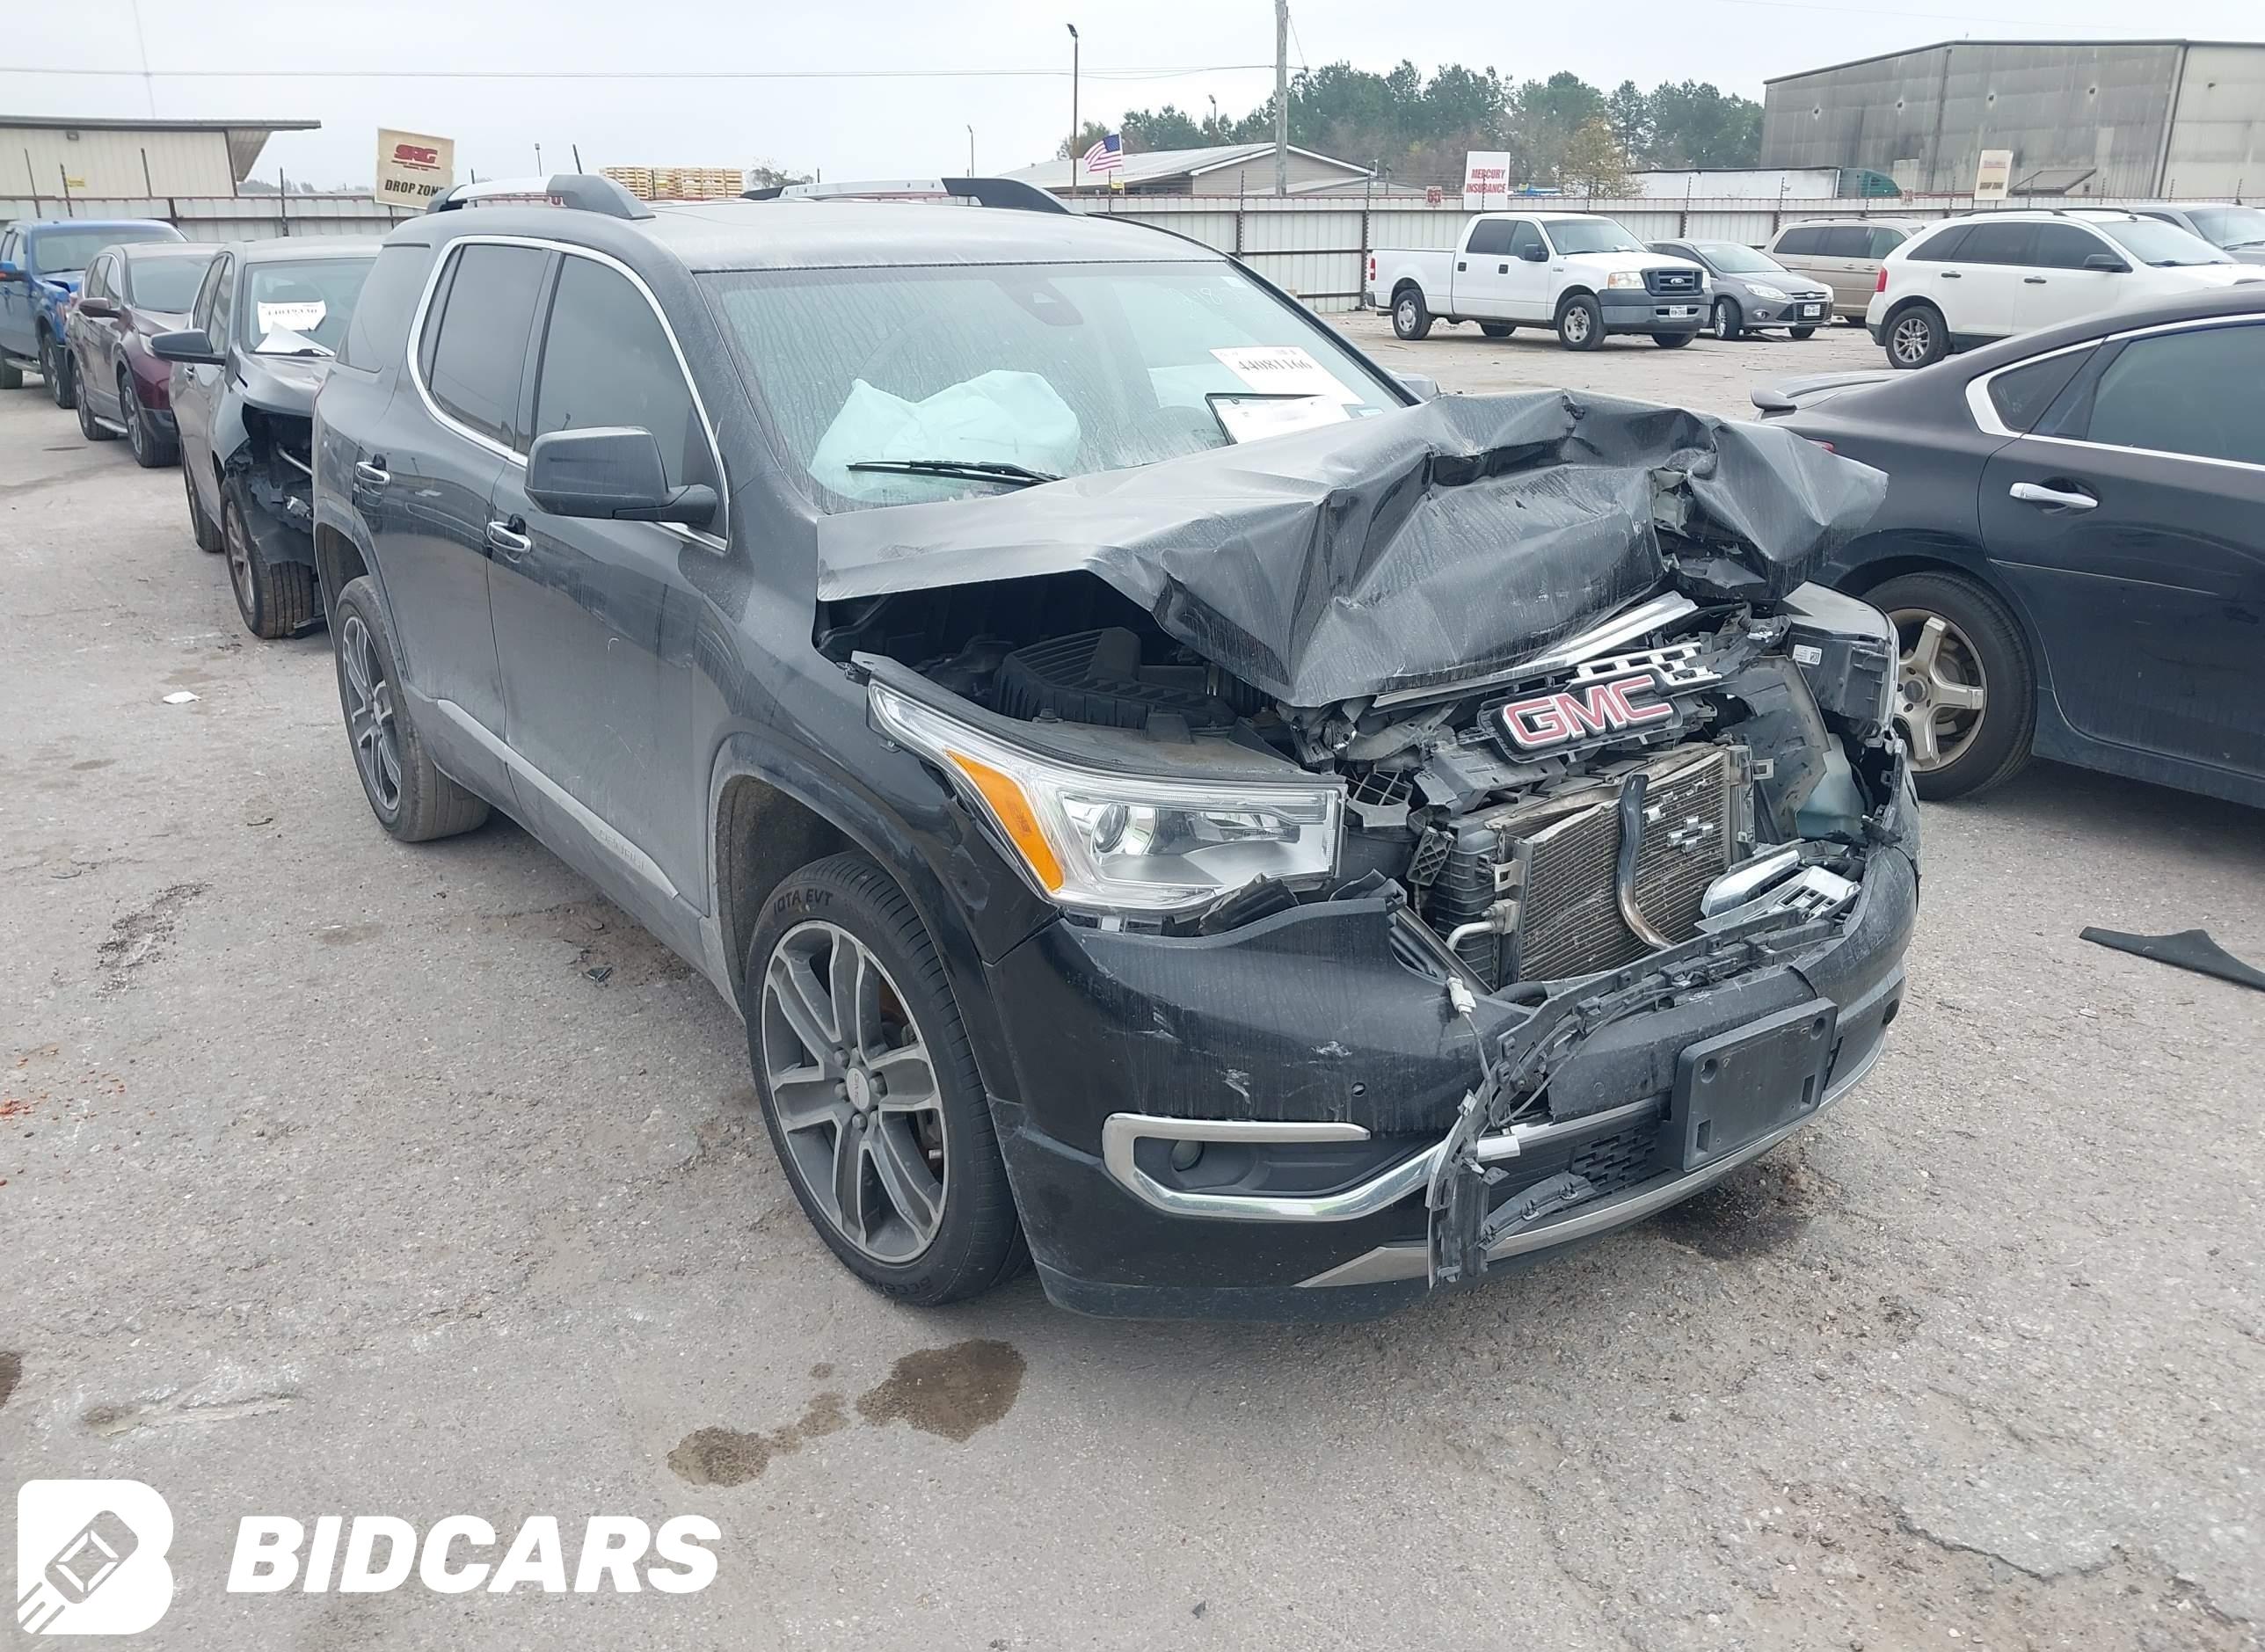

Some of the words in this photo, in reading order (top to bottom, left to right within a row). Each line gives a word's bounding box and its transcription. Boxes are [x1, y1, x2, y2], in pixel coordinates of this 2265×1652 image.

[394, 144, 438, 164] SRG
[1471, 168, 1505, 179] MERCURY
[384, 179, 416, 194] DROP
[417, 184, 444, 197] ZON
[1466, 183, 1506, 193] INSURANCE
[1503, 673, 1674, 749] GMC
[774, 890, 801, 915] IOTA
[806, 889, 834, 906] EVT
